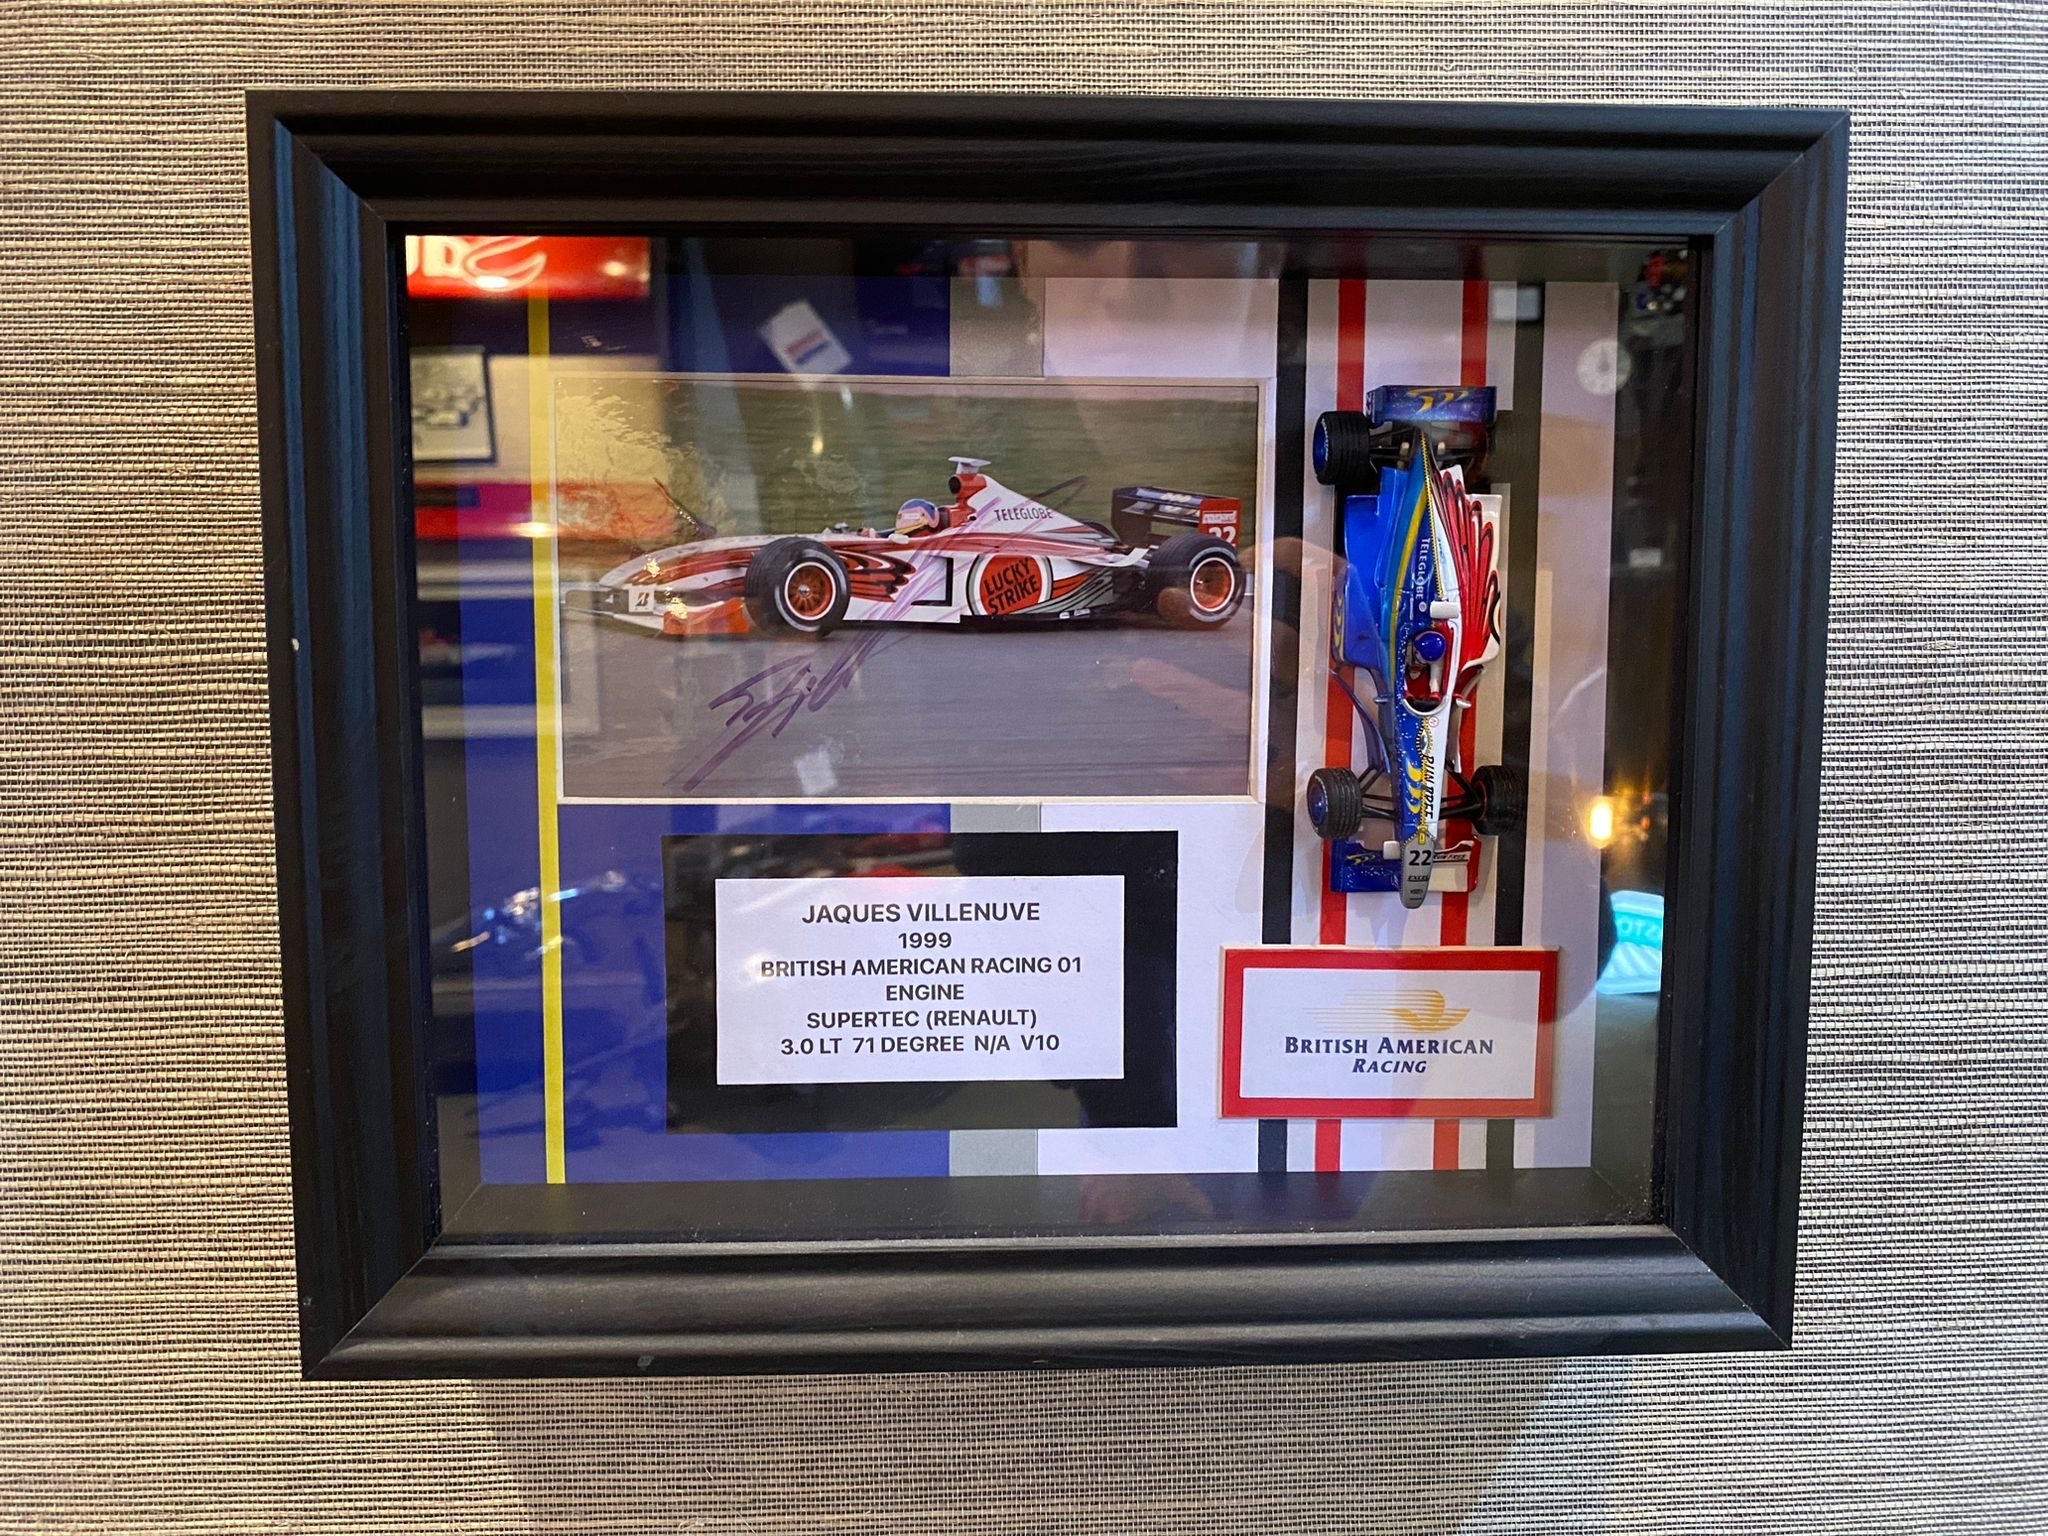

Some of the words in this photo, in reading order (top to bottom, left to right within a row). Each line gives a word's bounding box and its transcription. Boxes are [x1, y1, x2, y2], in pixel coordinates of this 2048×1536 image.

[993, 507, 1053, 522] TELEGLOBE
[984, 557, 1030, 596] LUCKY
[1415, 537, 1431, 600] TELEGLOBE
[987, 574, 1040, 616] STRIKE
[1408, 849, 1432, 866] 22
[802, 904, 900, 924] JAQUES
[907, 903, 1040, 922] VILLENUVE
[898, 932, 952, 949] 1999
[761, 959, 846, 977] BRITISH
[852, 958, 965, 976] AMERICAN
[971, 957, 1052, 974] RACING
[1058, 957, 1081, 973] 01
[886, 984, 964, 1001] ENGINE
[807, 1011, 919, 1029] SUPERTEC
[926, 1009, 1037, 1030] (RENAULT)
[781, 1038, 813, 1055] 3.0
[820, 1038, 842, 1054] LT
[853, 1037, 874, 1053] 71
[881, 1036, 964, 1053] DEGREE
[975, 1035, 1010, 1055] N/A
[1021, 1035, 1060, 1051] V10
